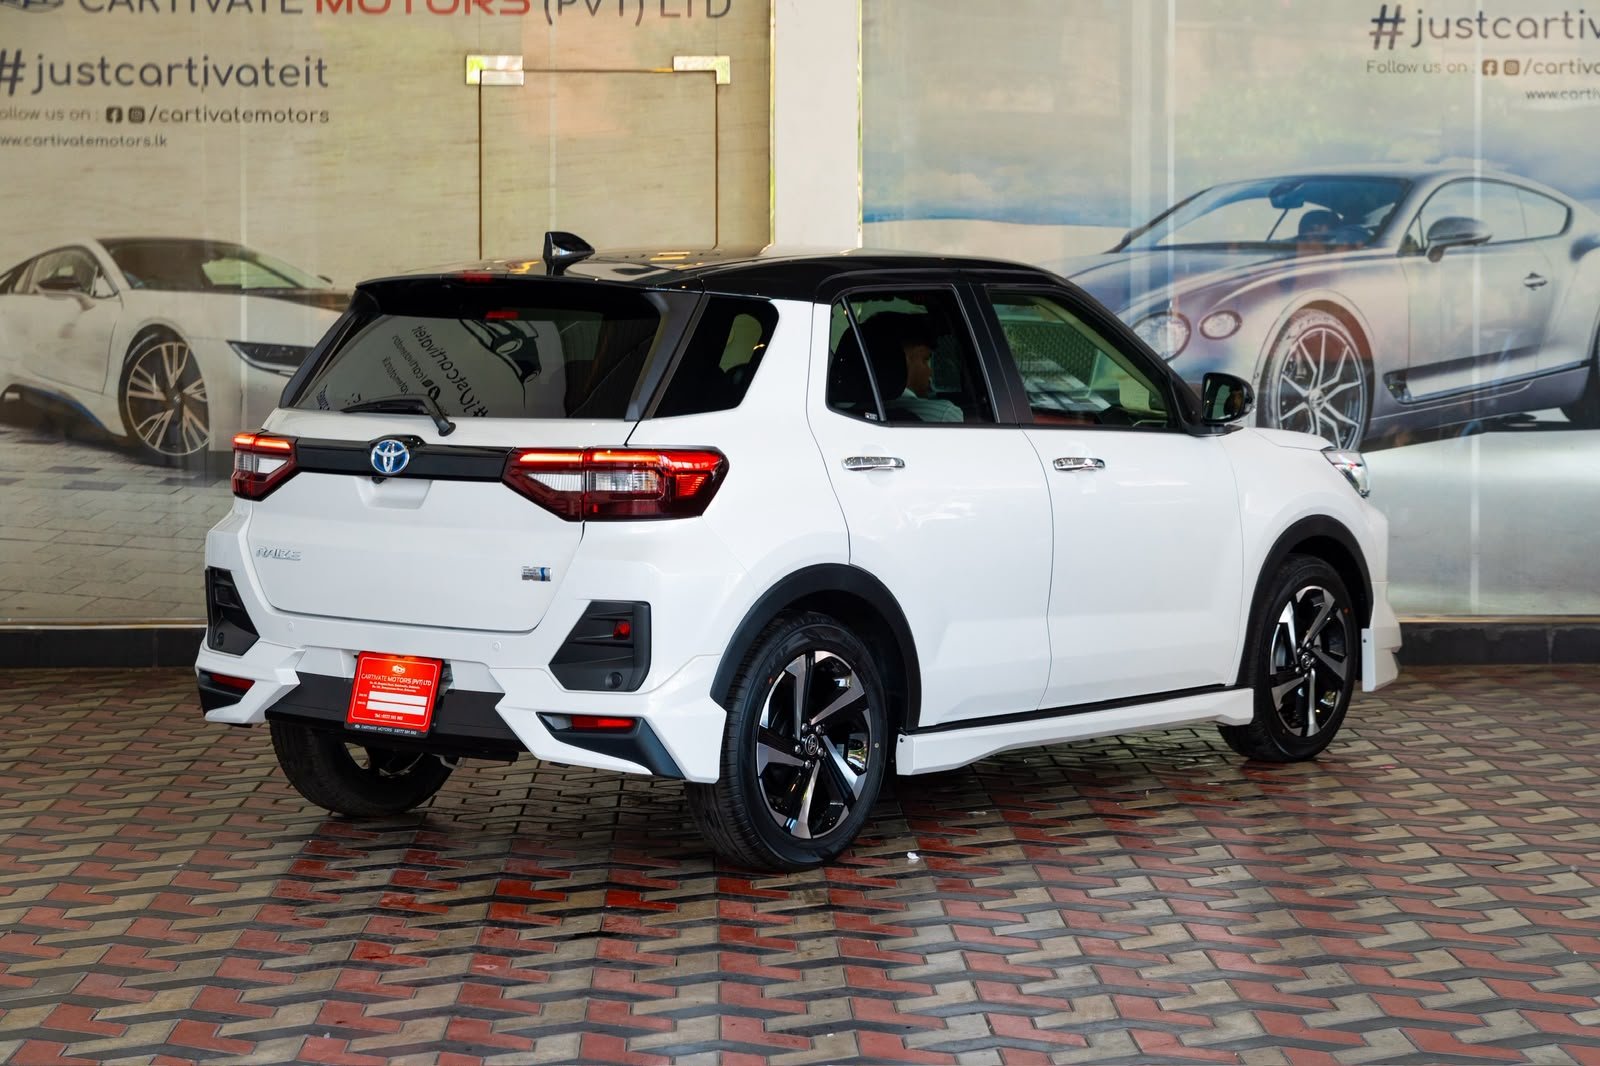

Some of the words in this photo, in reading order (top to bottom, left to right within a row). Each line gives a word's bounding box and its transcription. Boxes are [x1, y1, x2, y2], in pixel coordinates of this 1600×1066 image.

[0, 48, 329, 96] #justcartivateit
[1366, 59, 1418, 75] Follow
[1423, 62, 1441, 75] us
[1447, 62, 1467, 75] on
[45, 108, 63, 121] us
[70, 108, 90, 121] on
[149, 105, 329, 123] /cartivatemotors
